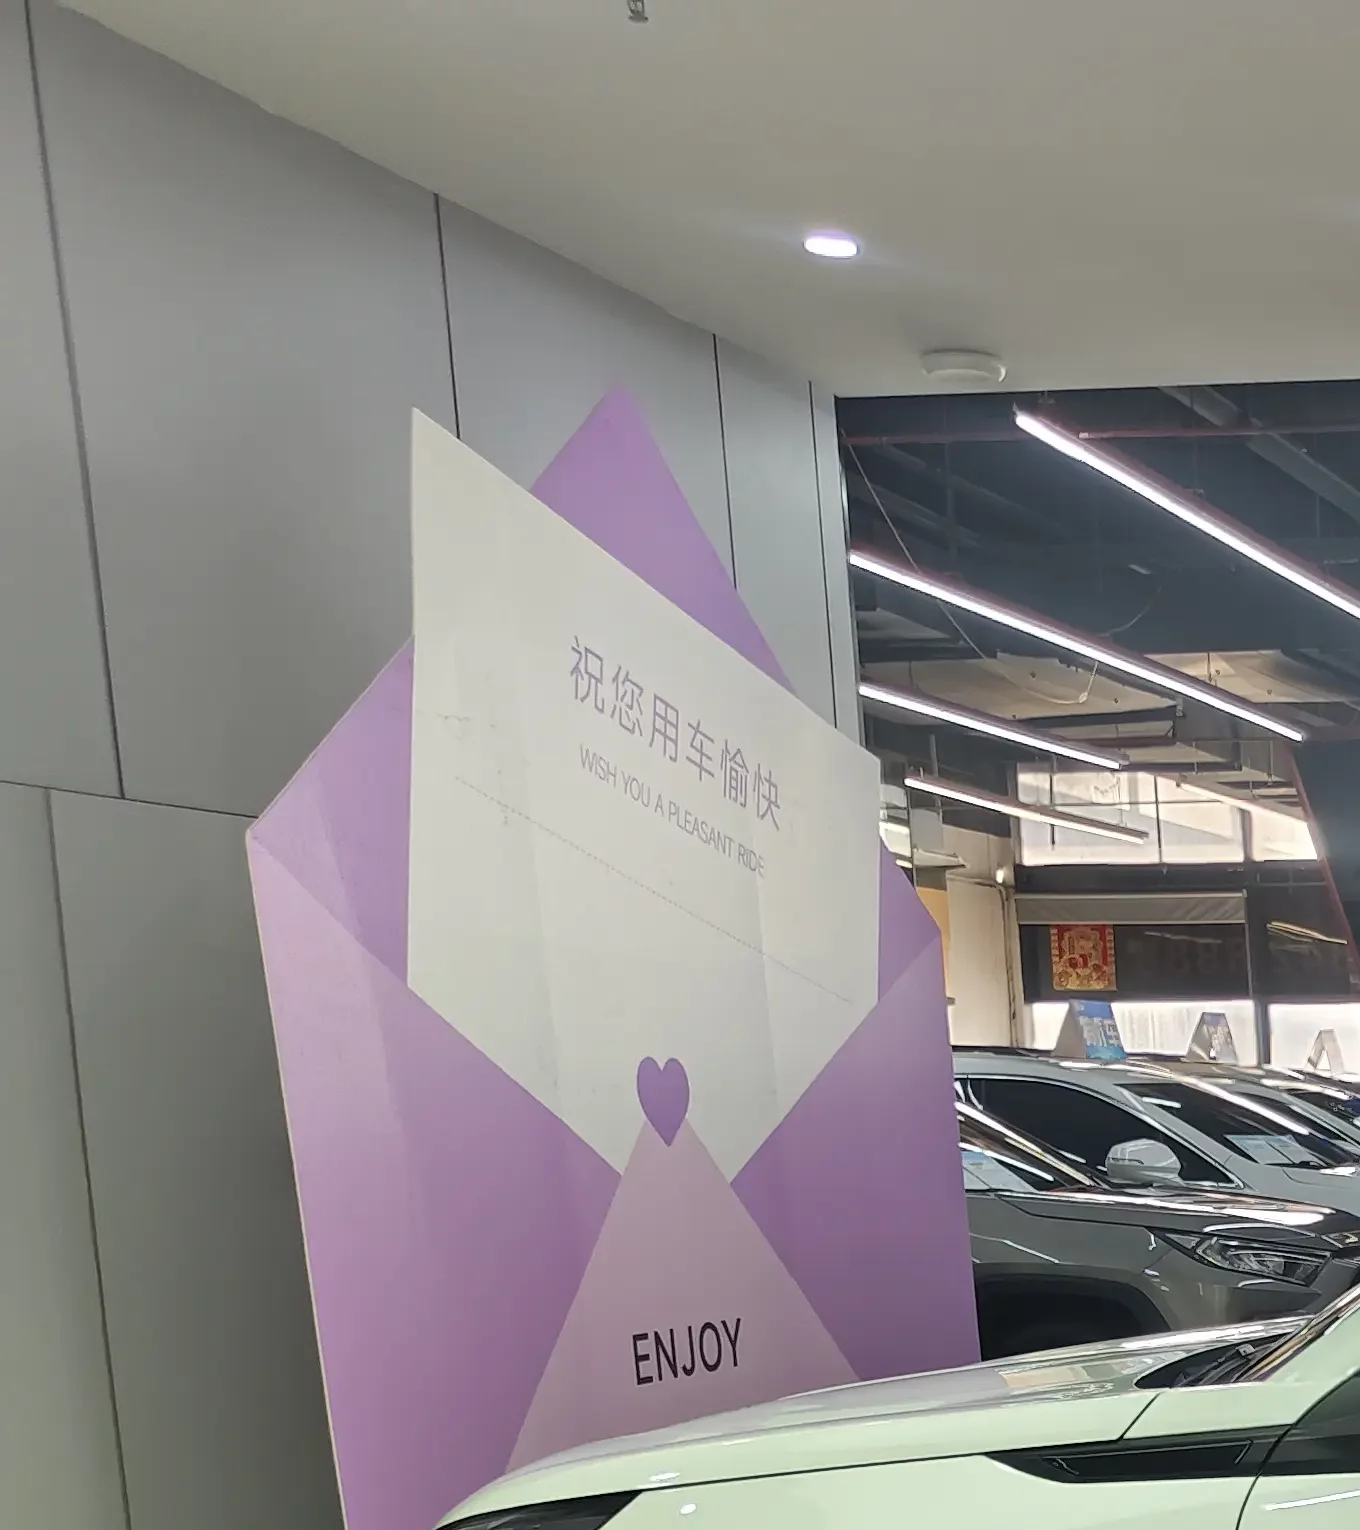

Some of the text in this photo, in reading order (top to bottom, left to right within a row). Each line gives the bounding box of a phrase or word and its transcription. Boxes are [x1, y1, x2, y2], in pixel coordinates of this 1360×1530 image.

[570, 635, 781, 831] 祝您用车愉快
[579, 744, 765, 879] WISH YOU A PLEASANT RIDE
[631, 1317, 742, 1386] ENJOY
